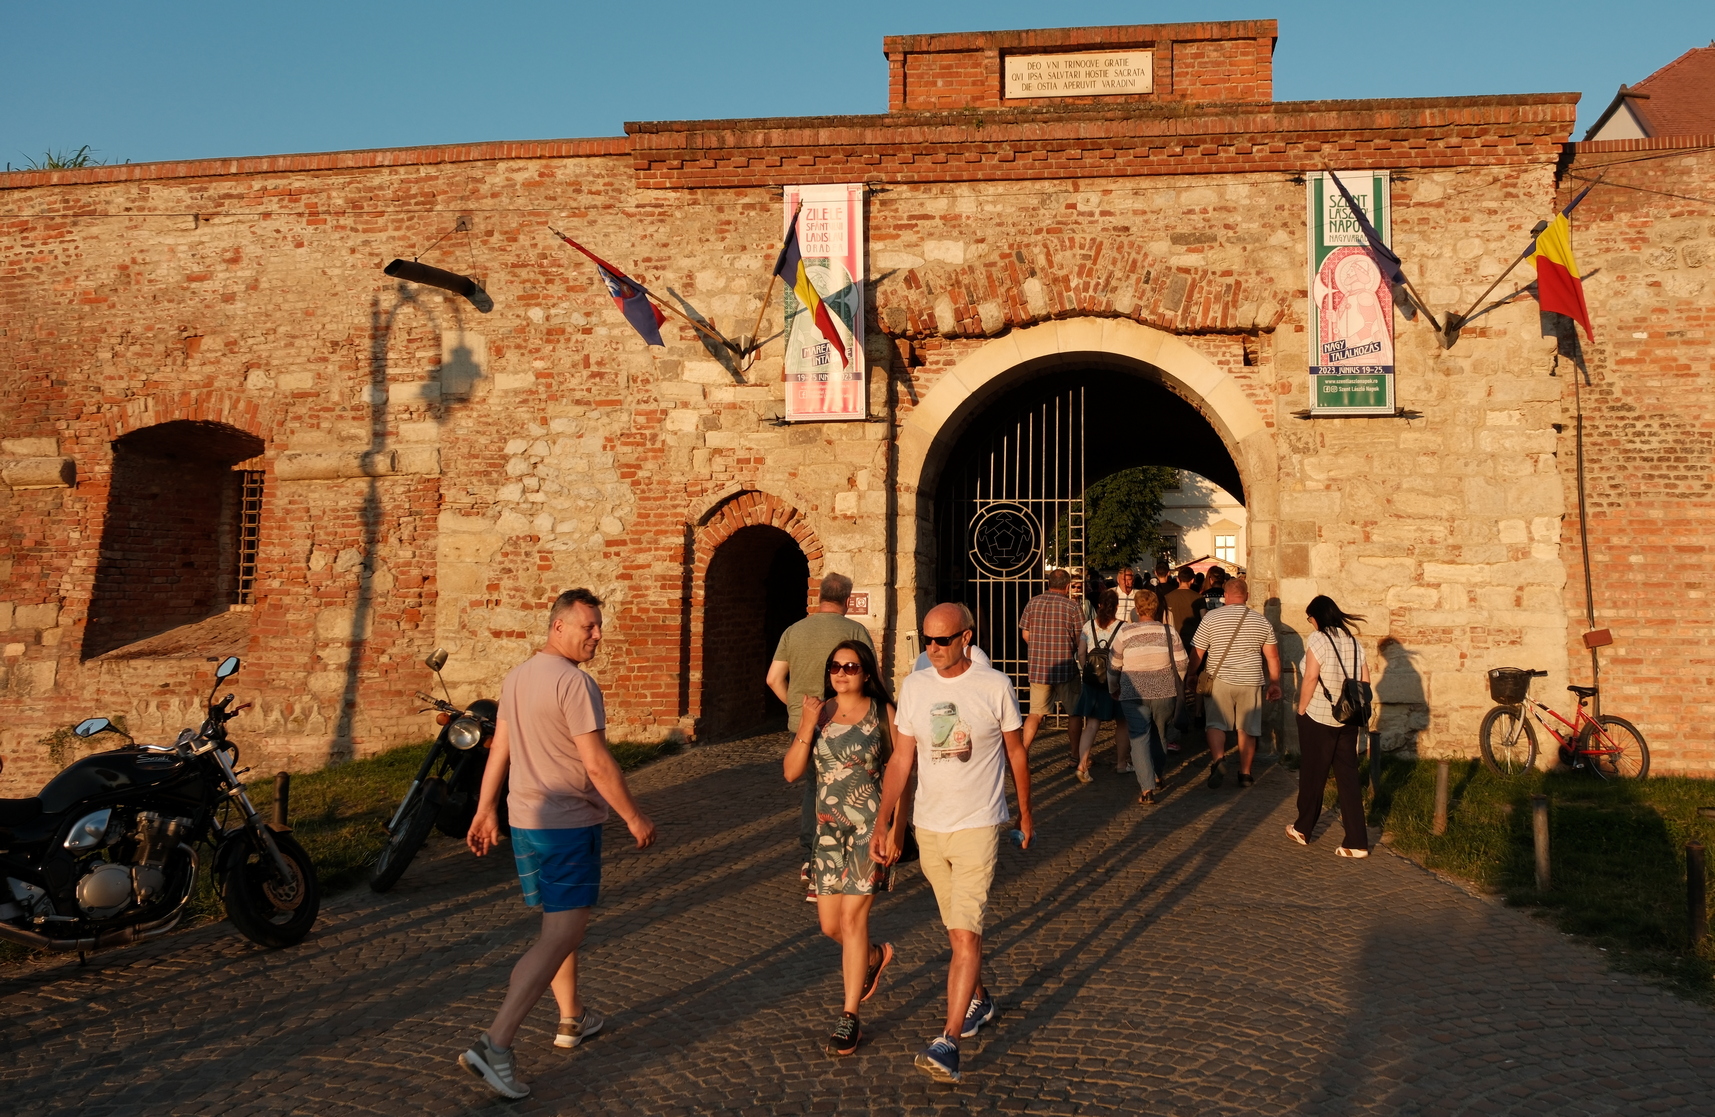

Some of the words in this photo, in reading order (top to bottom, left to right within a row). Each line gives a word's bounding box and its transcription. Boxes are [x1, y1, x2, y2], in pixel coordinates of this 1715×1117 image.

[1027, 61, 1041, 70] DEO
[1046, 61, 1060, 69] VNI
[1064, 60, 1099, 69] TRINOQVE
[1104, 58, 1129, 67] GRATIE
[1011, 73, 1024, 81] QVI
[1027, 72, 1043, 80] IPSA
[1047, 70, 1081, 79] SALVTARI
[1085, 69, 1109, 78] HOSTIE
[1114, 68, 1145, 77] SACRATA
[1021, 83, 1032, 91] DIE
[1037, 82, 1058, 90] OSTIA
[1101, 79, 1136, 88] VARADINI
[805, 207, 843, 221] ZILELE
[1329, 220, 1363, 233] NAPO
[805, 243, 844, 253] ORADEA
[803, 343, 831, 357] MAREA
[1324, 340, 1345, 353] NAGY
[1330, 341, 1380, 361] TALÁLKOZÁS
[1318, 366, 1338, 374] 2023.
[1338, 364, 1360, 375] JÚNIUS
